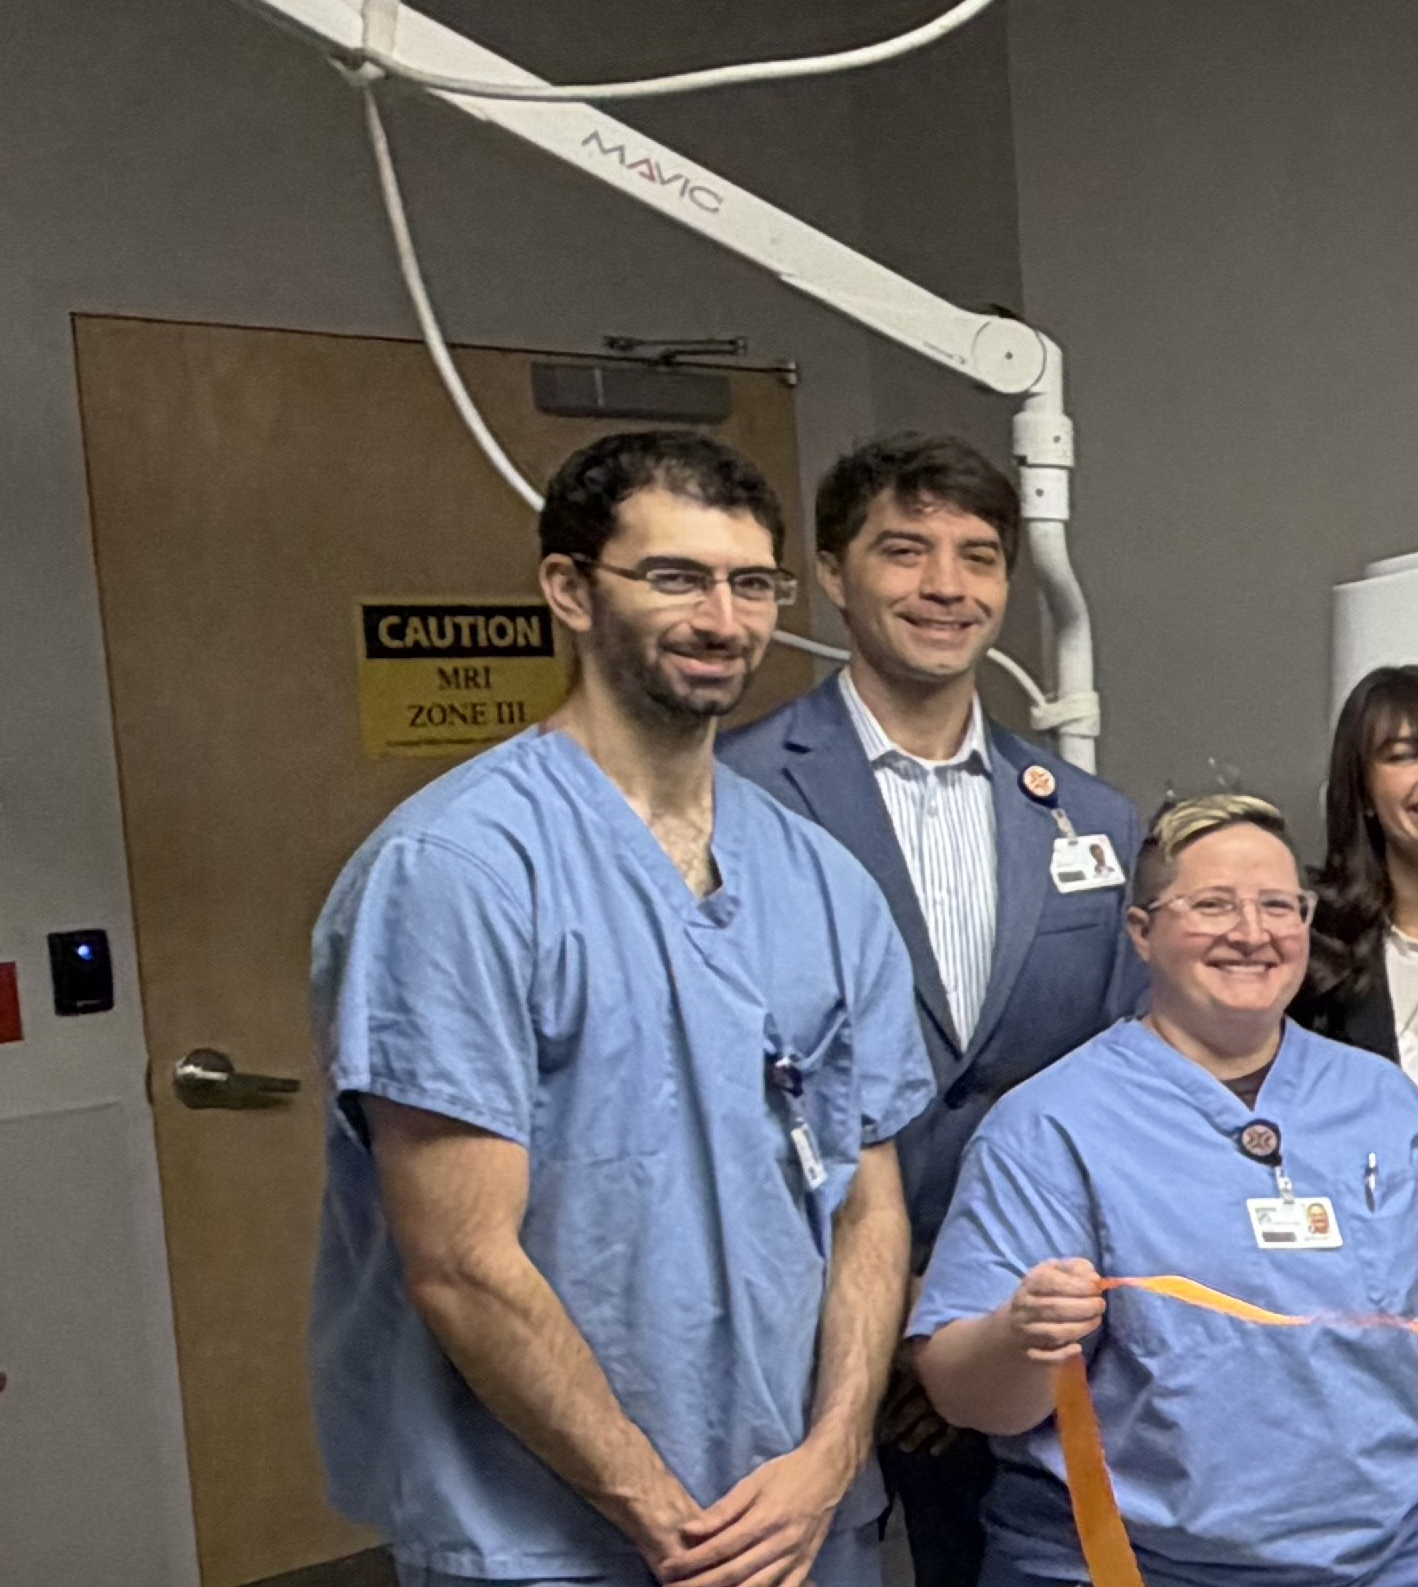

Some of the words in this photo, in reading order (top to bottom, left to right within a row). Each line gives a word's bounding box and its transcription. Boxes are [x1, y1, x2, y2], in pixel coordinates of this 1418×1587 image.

[580, 129, 724, 214] MAVIC
[377, 614, 543, 649] CAUTION
[436, 665, 492, 691] MRI
[407, 701, 488, 728] ZONE
[495, 699, 526, 725] III
